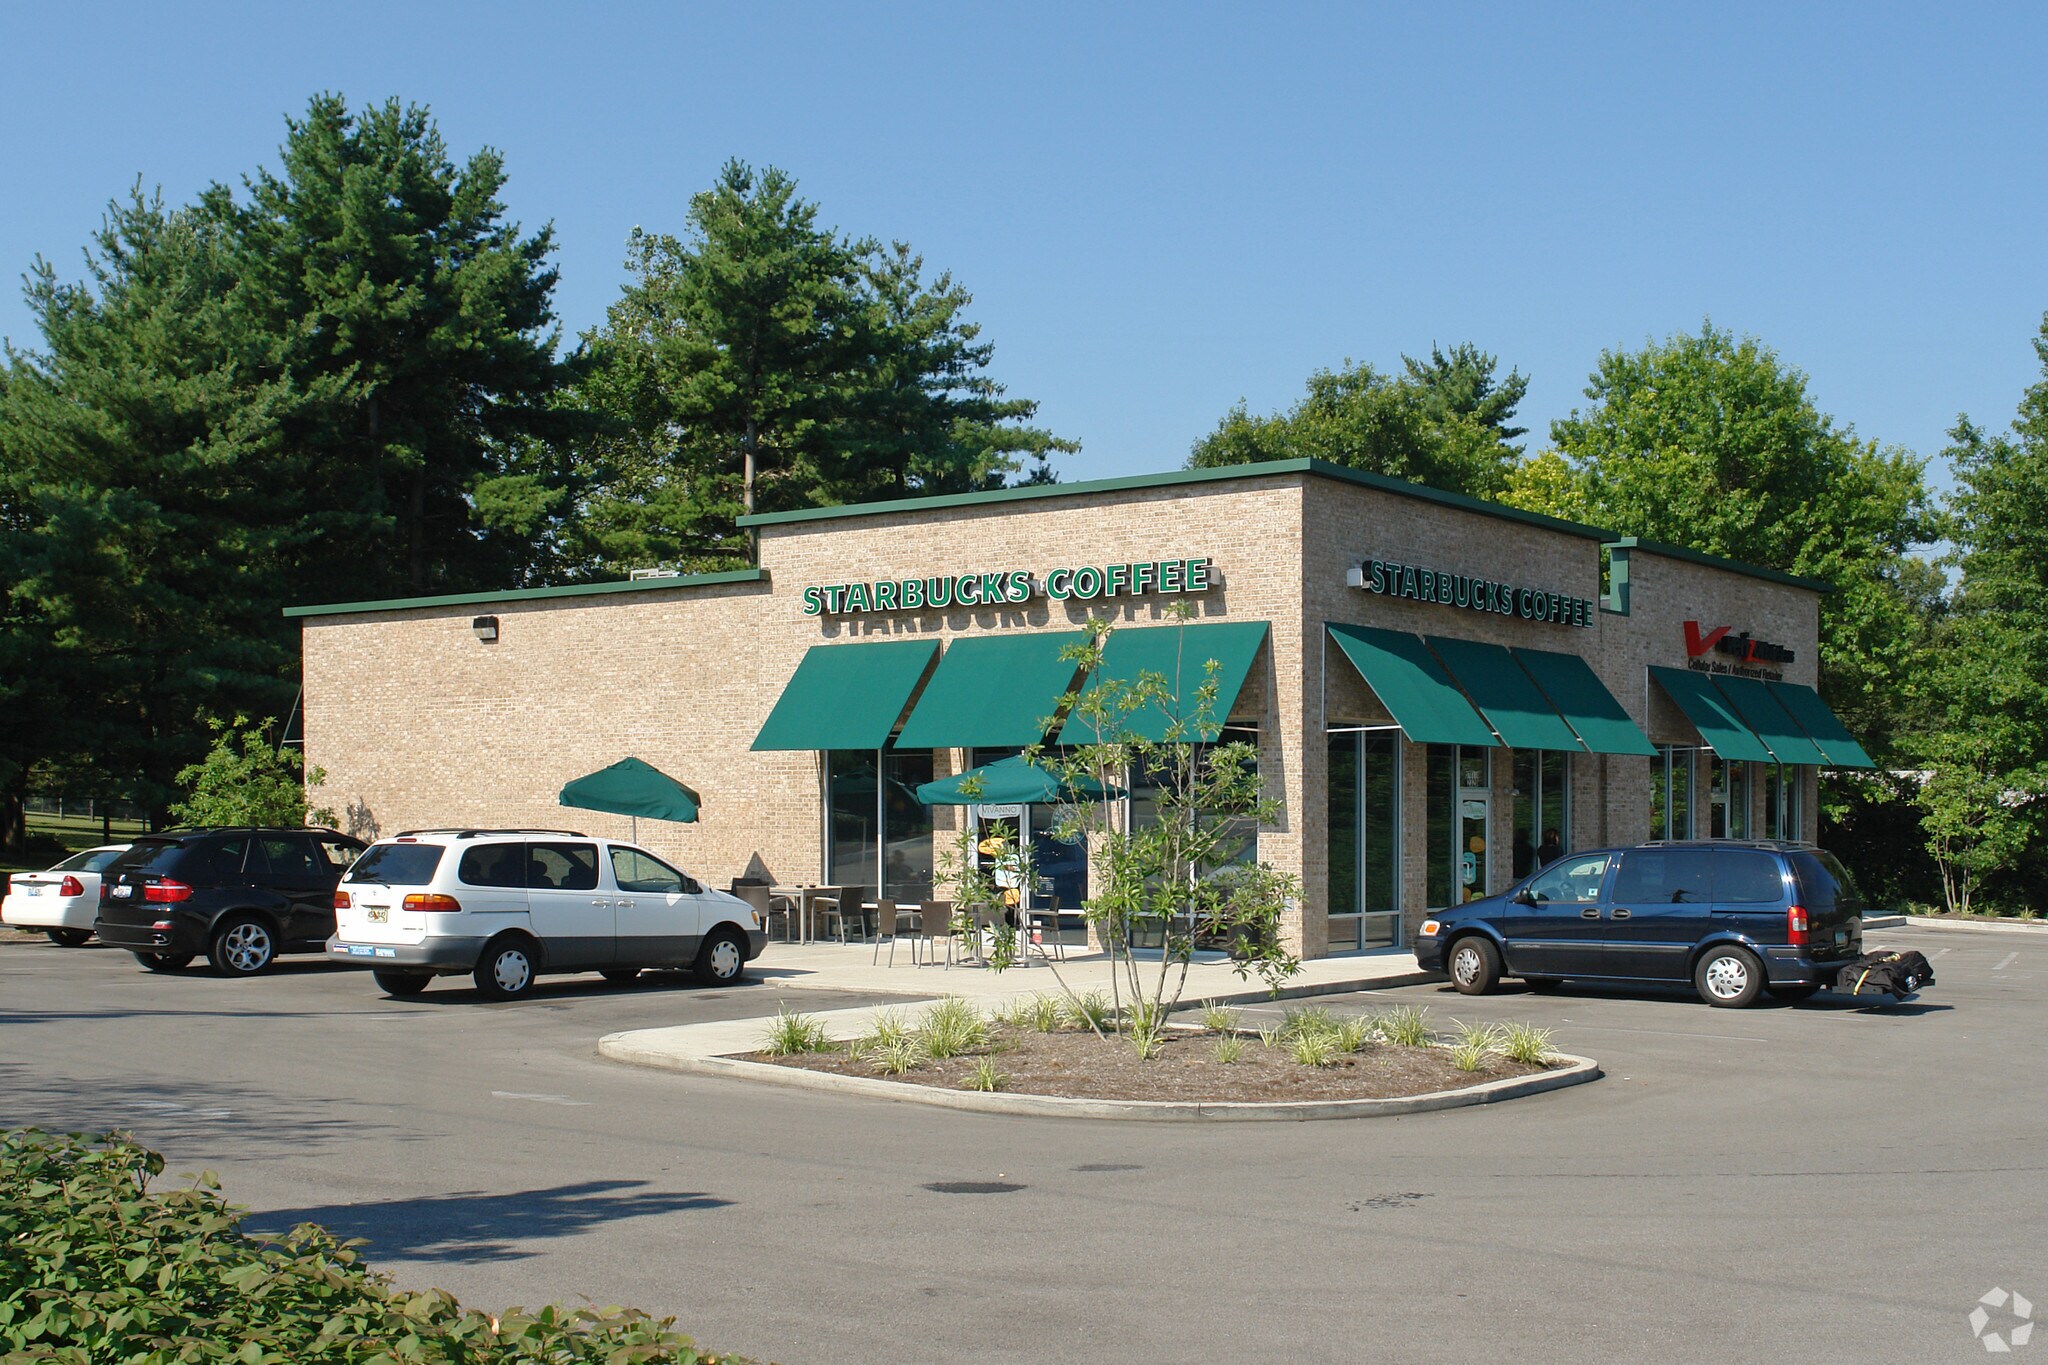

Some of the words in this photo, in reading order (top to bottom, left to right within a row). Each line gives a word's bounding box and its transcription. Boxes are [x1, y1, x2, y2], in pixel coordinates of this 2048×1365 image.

[802, 570, 1032, 616] STARBUCKS
[1046, 557, 1209, 601] COFFEE
[1370, 560, 1513, 616] STARBUCKS
[1519, 587, 1594, 628] COFFEE
